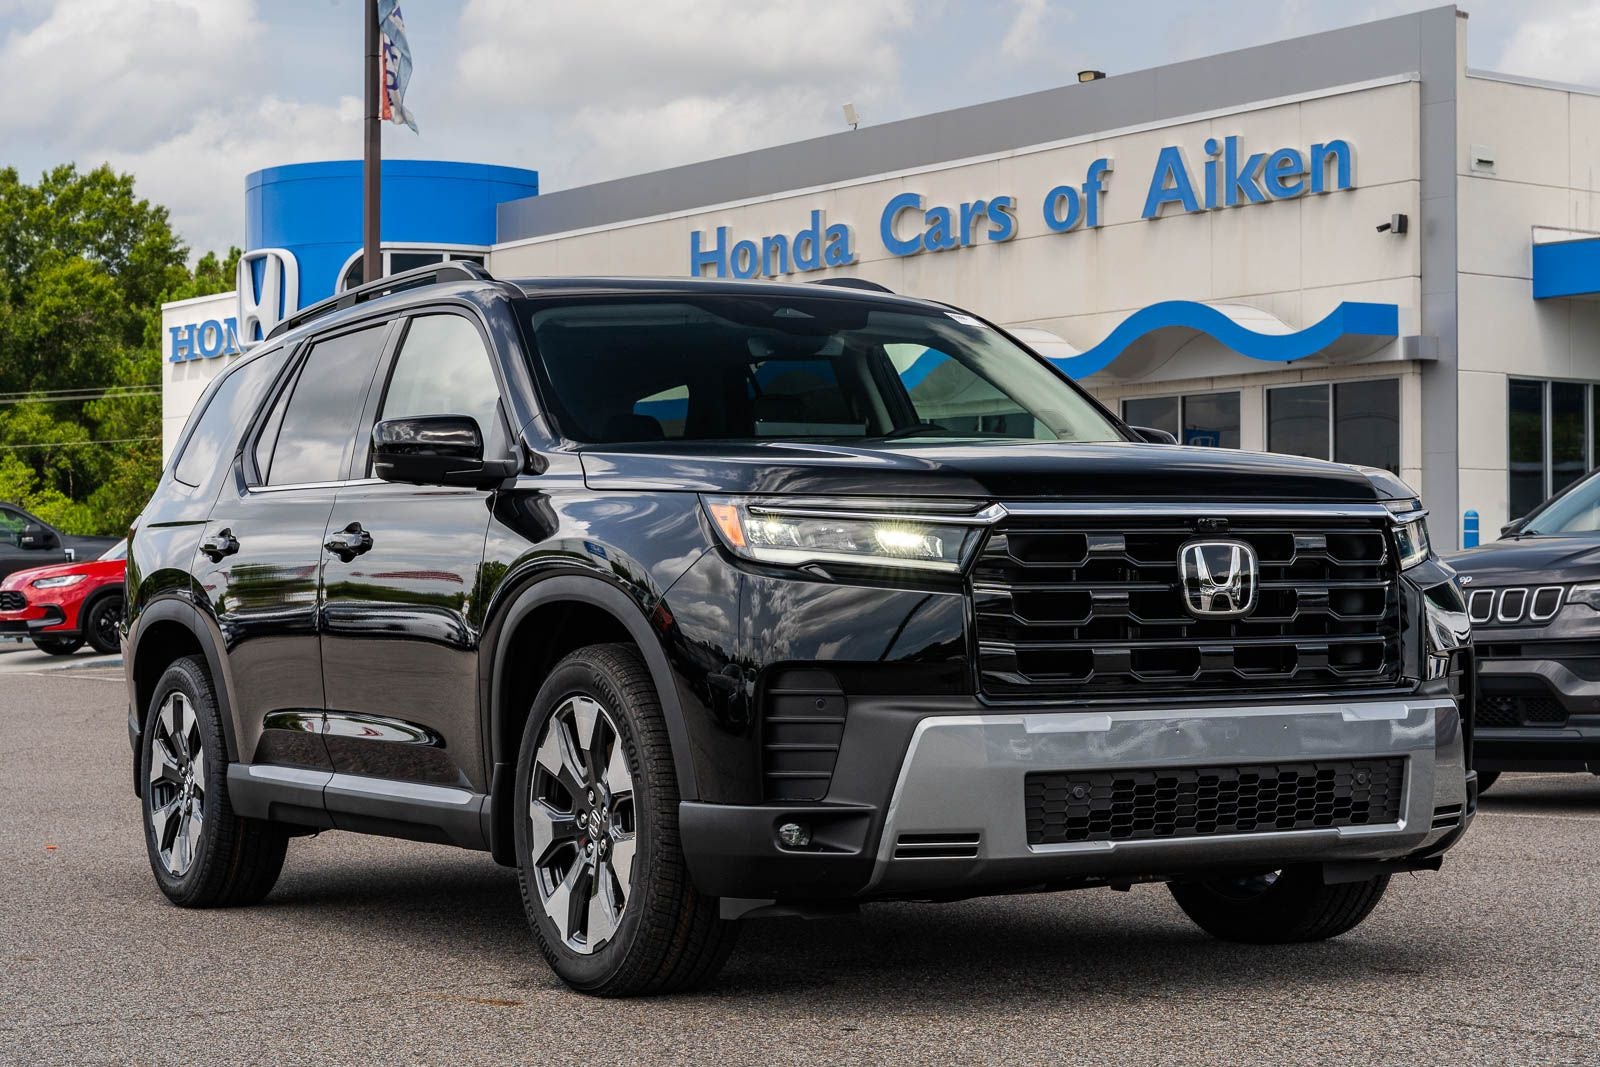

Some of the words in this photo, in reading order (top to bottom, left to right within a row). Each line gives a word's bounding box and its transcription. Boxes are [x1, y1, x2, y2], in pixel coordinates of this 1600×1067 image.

[691, 209, 856, 279] Honda
[880, 192, 1016, 257] Cars
[1043, 158, 1113, 233] of
[1141, 135, 1355, 219] Aiken
[169, 317, 244, 363] HON
[593, 672, 643, 784] BRIDGESTONE
